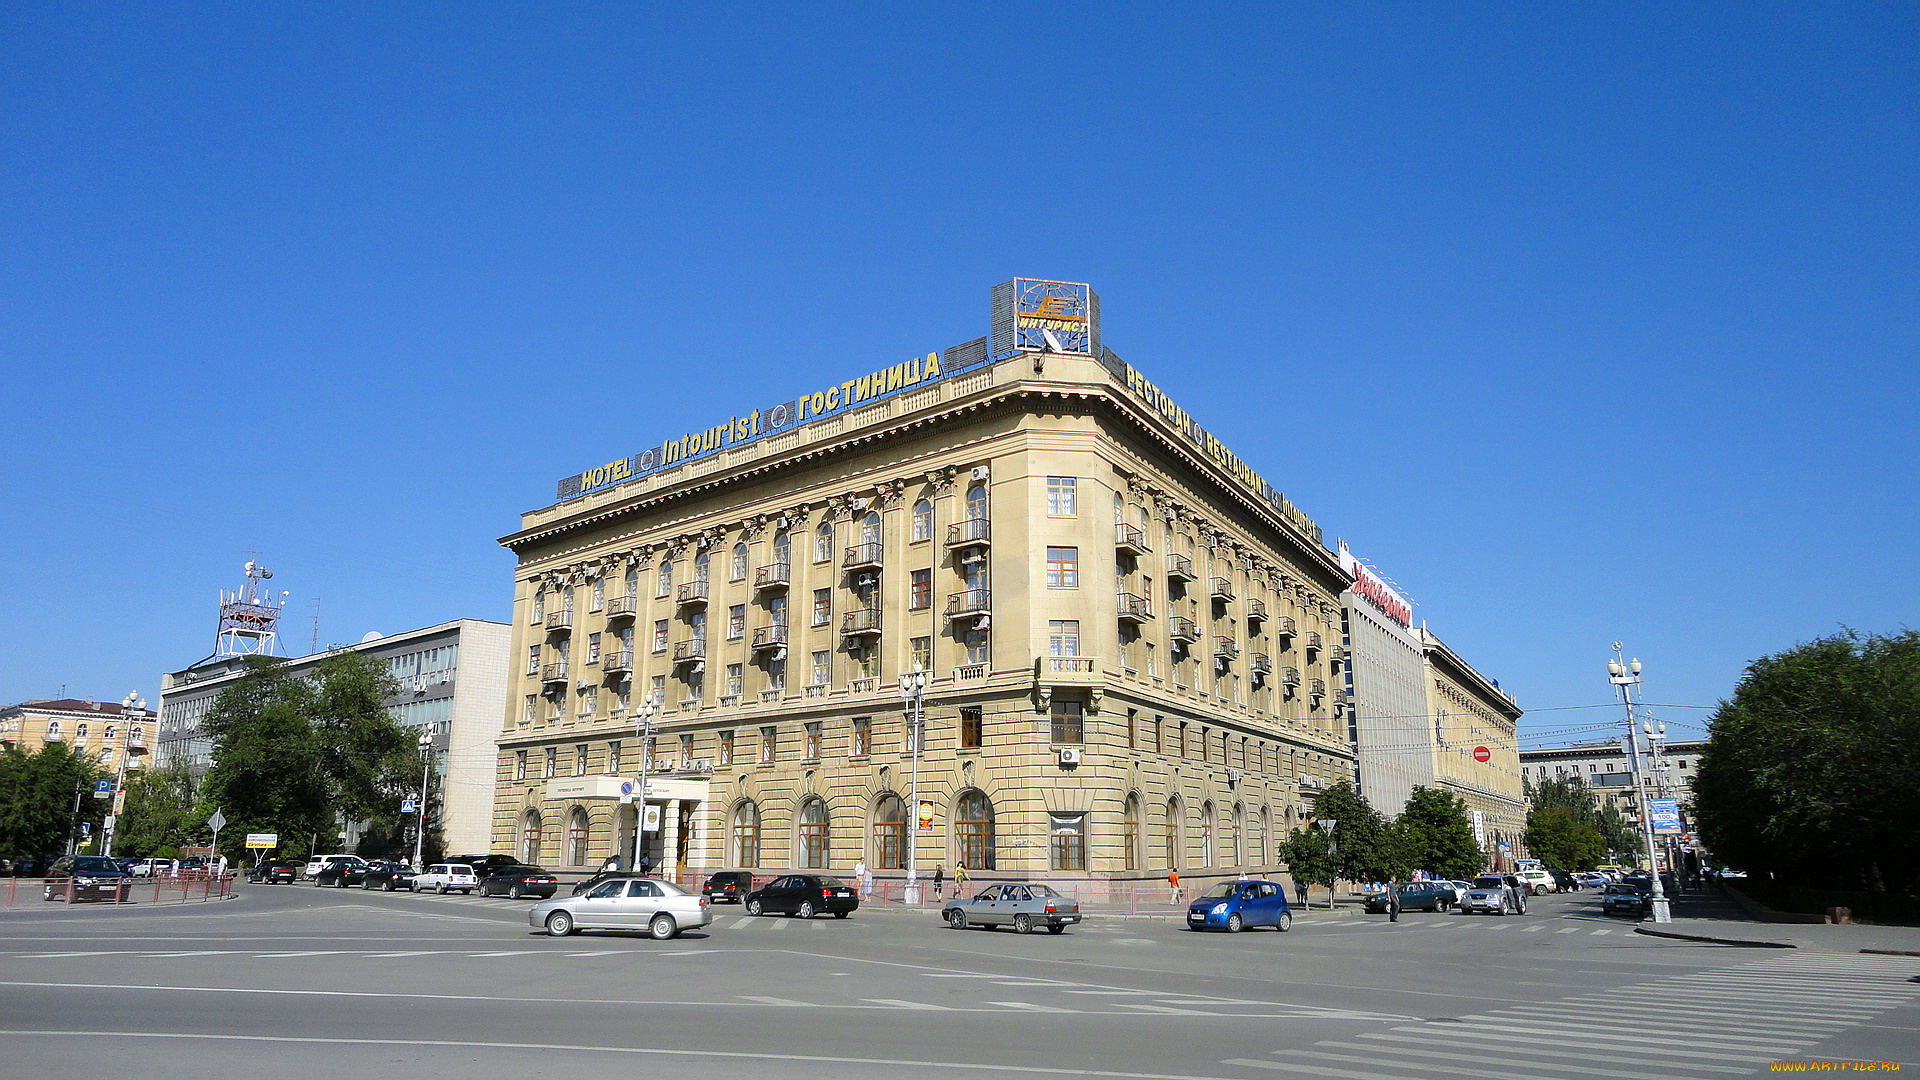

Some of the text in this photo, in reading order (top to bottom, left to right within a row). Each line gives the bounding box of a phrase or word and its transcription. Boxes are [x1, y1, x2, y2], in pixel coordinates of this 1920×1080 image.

[1019, 318, 1088, 333] ИНТУРИСТ
[798, 351, 940, 420] ГОСТИНИЦА
[1126, 362, 1191, 437] РЕСТОРАН
[580, 408, 759, 491] HOTEL Intourist
[1206, 431, 1268, 498] RESTAURANT
